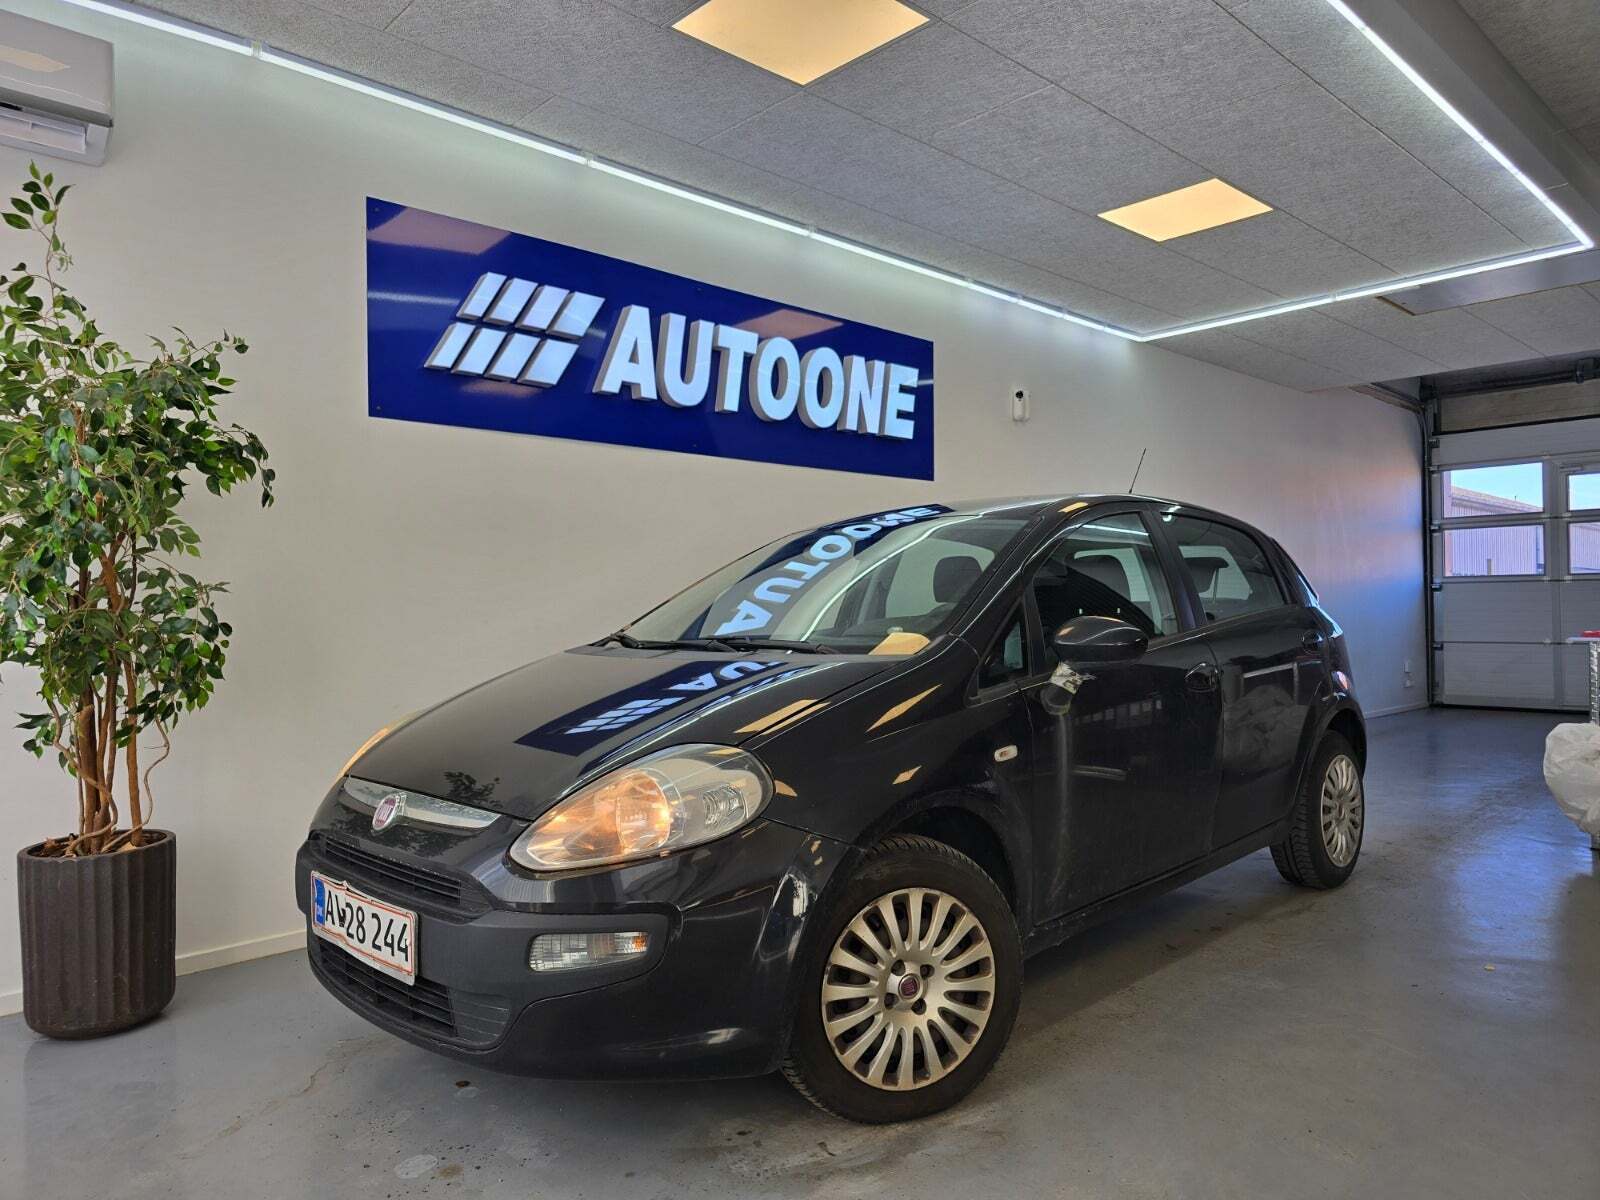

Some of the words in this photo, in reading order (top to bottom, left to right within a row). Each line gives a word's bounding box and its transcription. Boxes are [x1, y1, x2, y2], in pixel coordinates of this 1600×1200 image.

[593, 304, 919, 440] AUTOONE
[345, 902, 366, 944] 28
[371, 912, 409, 962] 244
